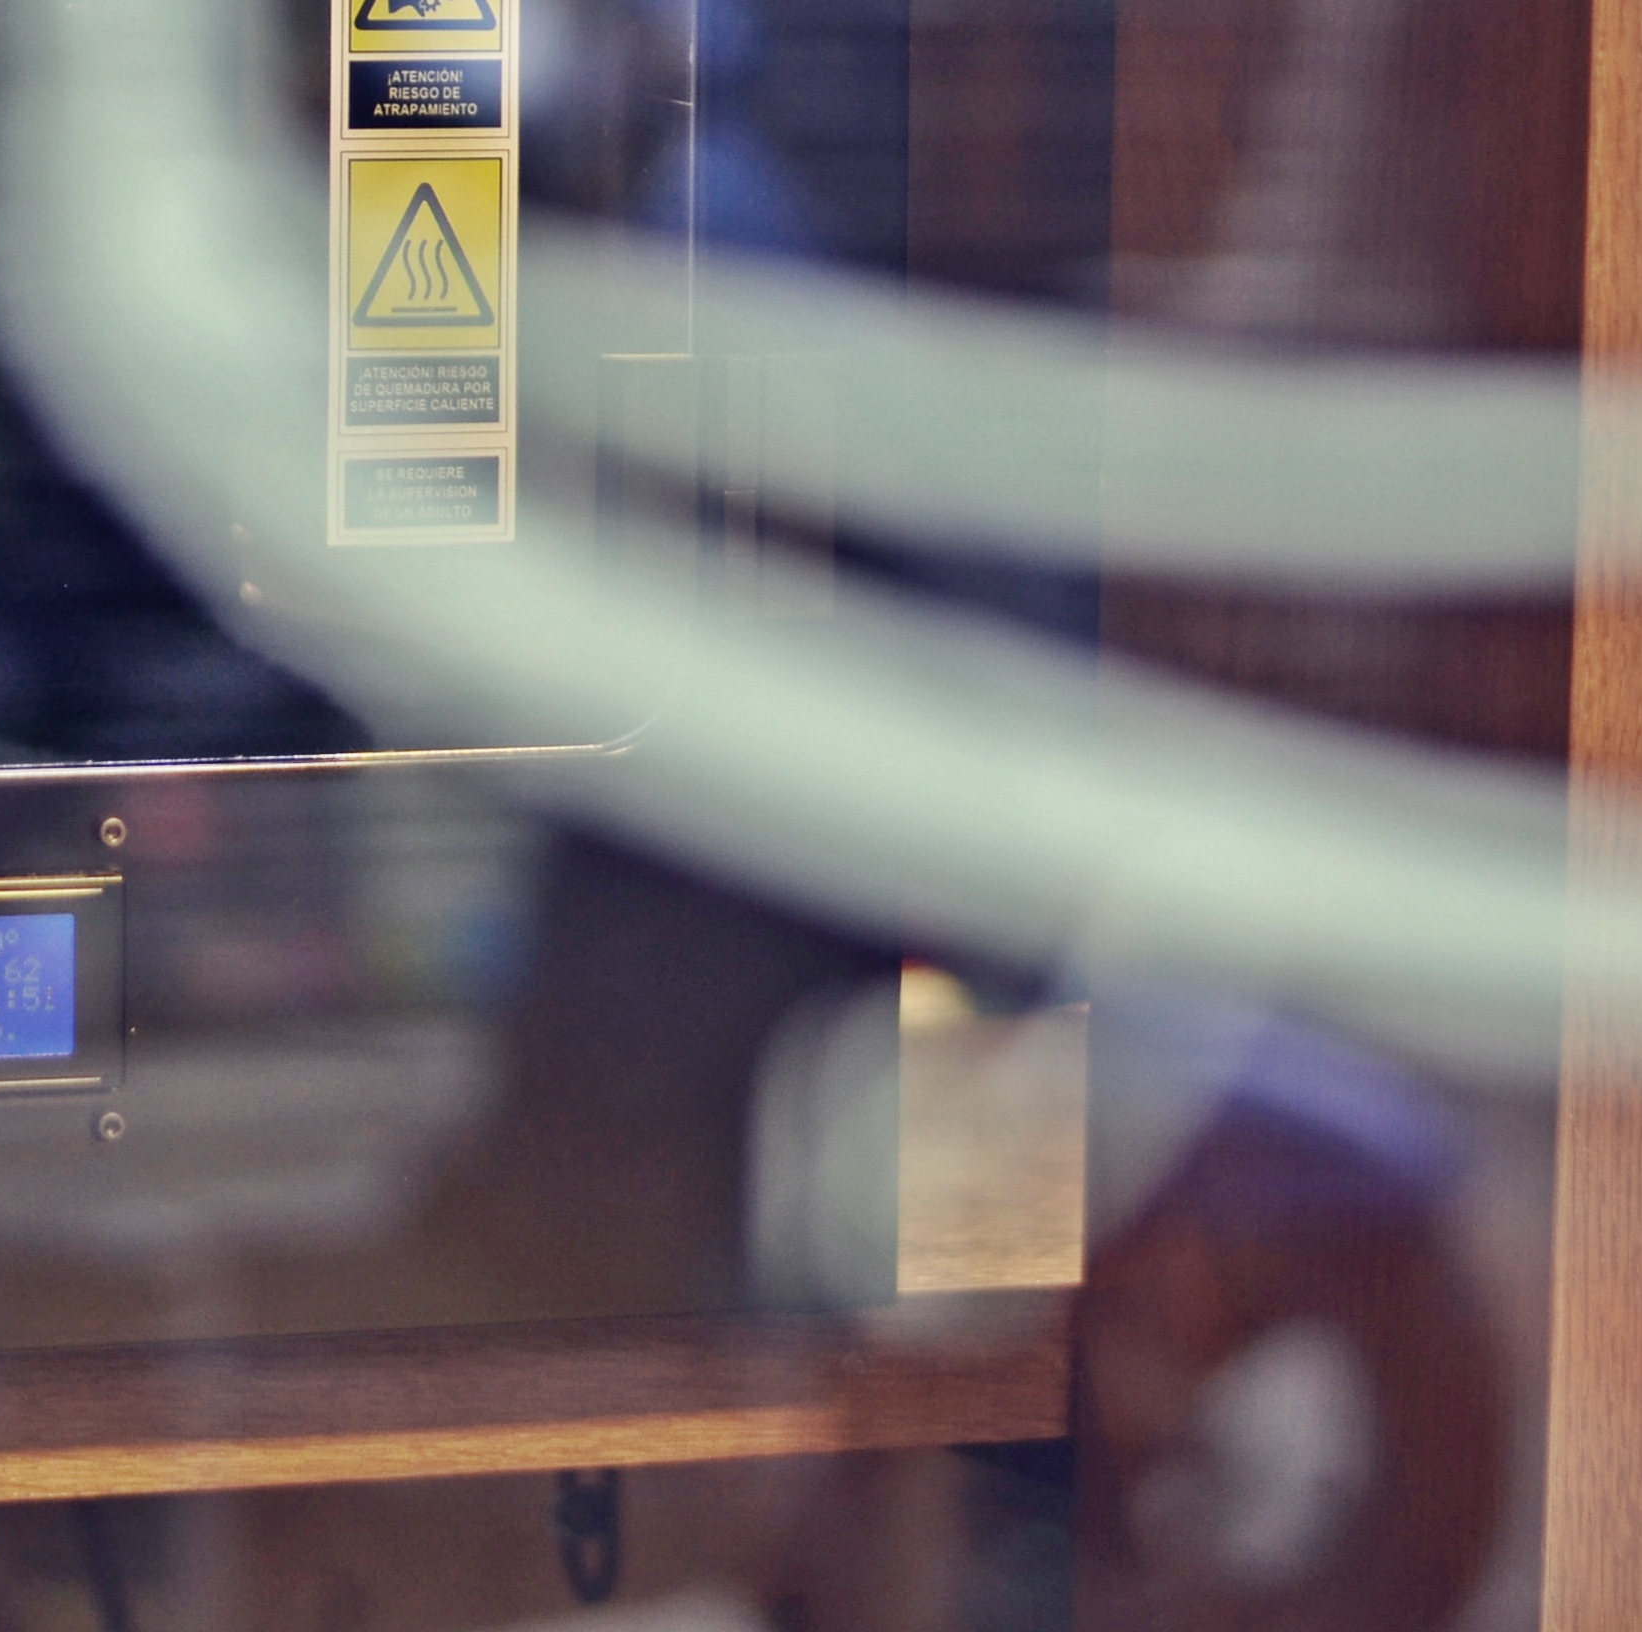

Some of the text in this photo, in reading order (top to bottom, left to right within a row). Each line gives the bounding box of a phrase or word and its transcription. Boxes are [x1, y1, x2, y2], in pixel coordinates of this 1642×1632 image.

[388, 68, 463, 85] ¡ATENCIÓN!
[389, 86, 461, 99] RIESGO DE
[373, 103, 477, 116] ATRAPAMIENTO
[437, 365, 487, 378] RIESGO
[353, 381, 491, 396] DE QUEMADURA POR
[350, 397, 494, 412] SUPERFICIE CALIENTE
[397, 466, 464, 479] REQUIERE
[389, 485, 477, 500] SUPERVISION
